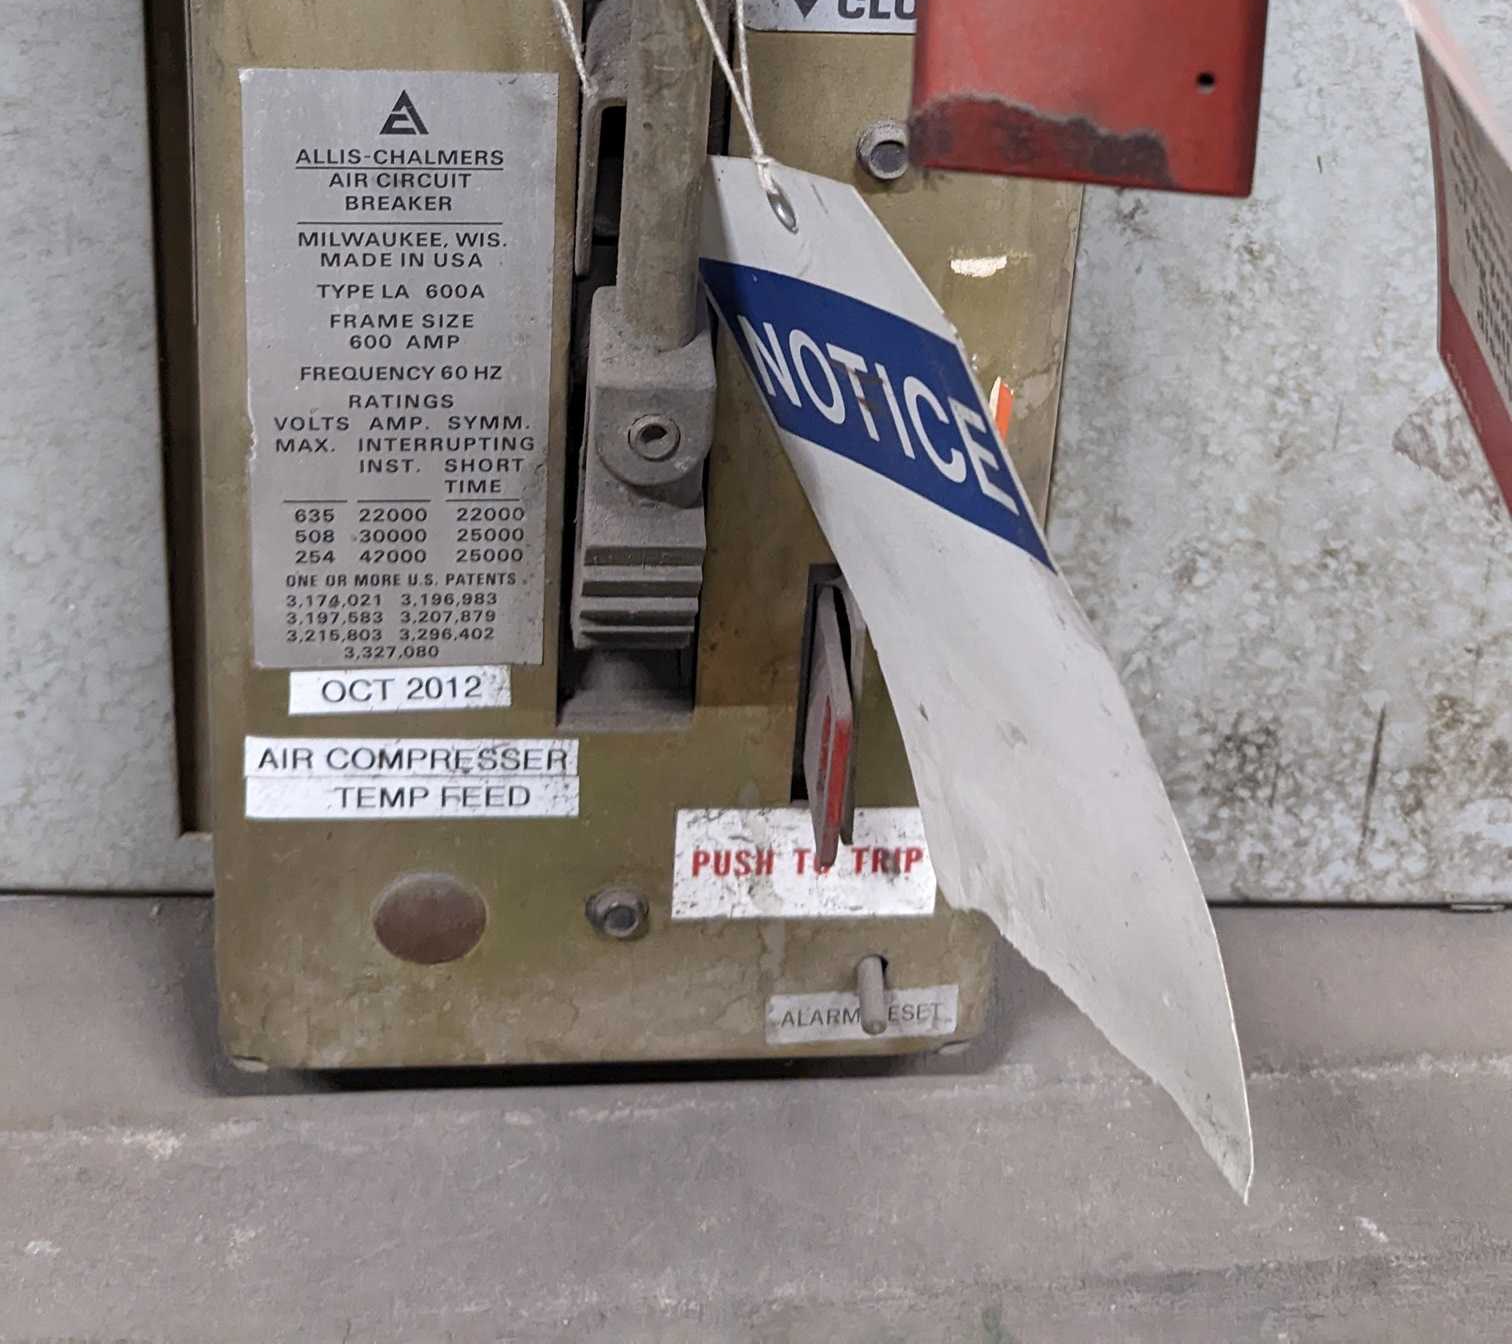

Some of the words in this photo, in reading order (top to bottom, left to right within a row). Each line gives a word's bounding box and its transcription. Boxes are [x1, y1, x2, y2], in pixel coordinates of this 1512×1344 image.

[296, 149, 504, 166] ALLIS-CHALMERS
[329, 173, 368, 188] AIR
[376, 173, 471, 189] CIRCUIT
[345, 196, 452, 211] BREAKER
[298, 232, 449, 248] MILWAUKEE,
[456, 232, 507, 248] WIS.
[320, 253, 392, 268] MADE
[401, 253, 424, 268] IN
[434, 253, 483, 268] USA
[317, 284, 374, 299] TYPE
[381, 284, 409, 299] LA
[426, 284, 485, 299] 600A
[330, 314, 414, 329] FRAME
[422, 314, 474, 329] SIZE
[350, 334, 392, 350] 600
[406, 334, 460, 350] AMP
[300, 366, 435, 382] FREQUENCY
[441, 366, 467, 380] 60
[474, 366, 503, 380] HZ
[348, 394, 454, 409] RATINGS
[274, 416, 350, 432] VOLTS
[369, 416, 430, 431] AMP.
[447, 415, 531, 430] SYMM.
[737, 315, 1020, 516] NOTICE
[276, 438, 336, 453] MAX.
[358, 437, 535, 453] INTERRUPTING
[359, 459, 421, 474] INST.
[444, 458, 525, 473] SHORT
[444, 479, 502, 494] TIME
[294, 508, 335, 523] 635
[358, 508, 428, 523] 22000
[456, 507, 525, 522] 22000
[295, 529, 335, 544] 508
[358, 529, 428, 544] 30000
[456, 528, 525, 543] 25000
[295, 549, 336, 564] 254
[456, 548, 524, 563] 25000
[286, 574, 318, 588] ONE
[325, 574, 347, 587] OR
[354, 574, 401, 587] MORE
[407, 573, 438, 587] U.S.
[445, 573, 517, 587] PATENTS
[321, 677, 396, 703] OCT
[406, 675, 483, 701] 2012
[258, 747, 313, 770] AIR
[326, 747, 568, 771] COMPRESSER
[334, 785, 429, 808] TEMP
[441, 785, 531, 808] FEED
[691, 848, 776, 877] PUSH
[851, 847, 924, 876] TRIP
[781, 1007, 862, 1028] ALARM
[887, 1002, 943, 1023] ESET
